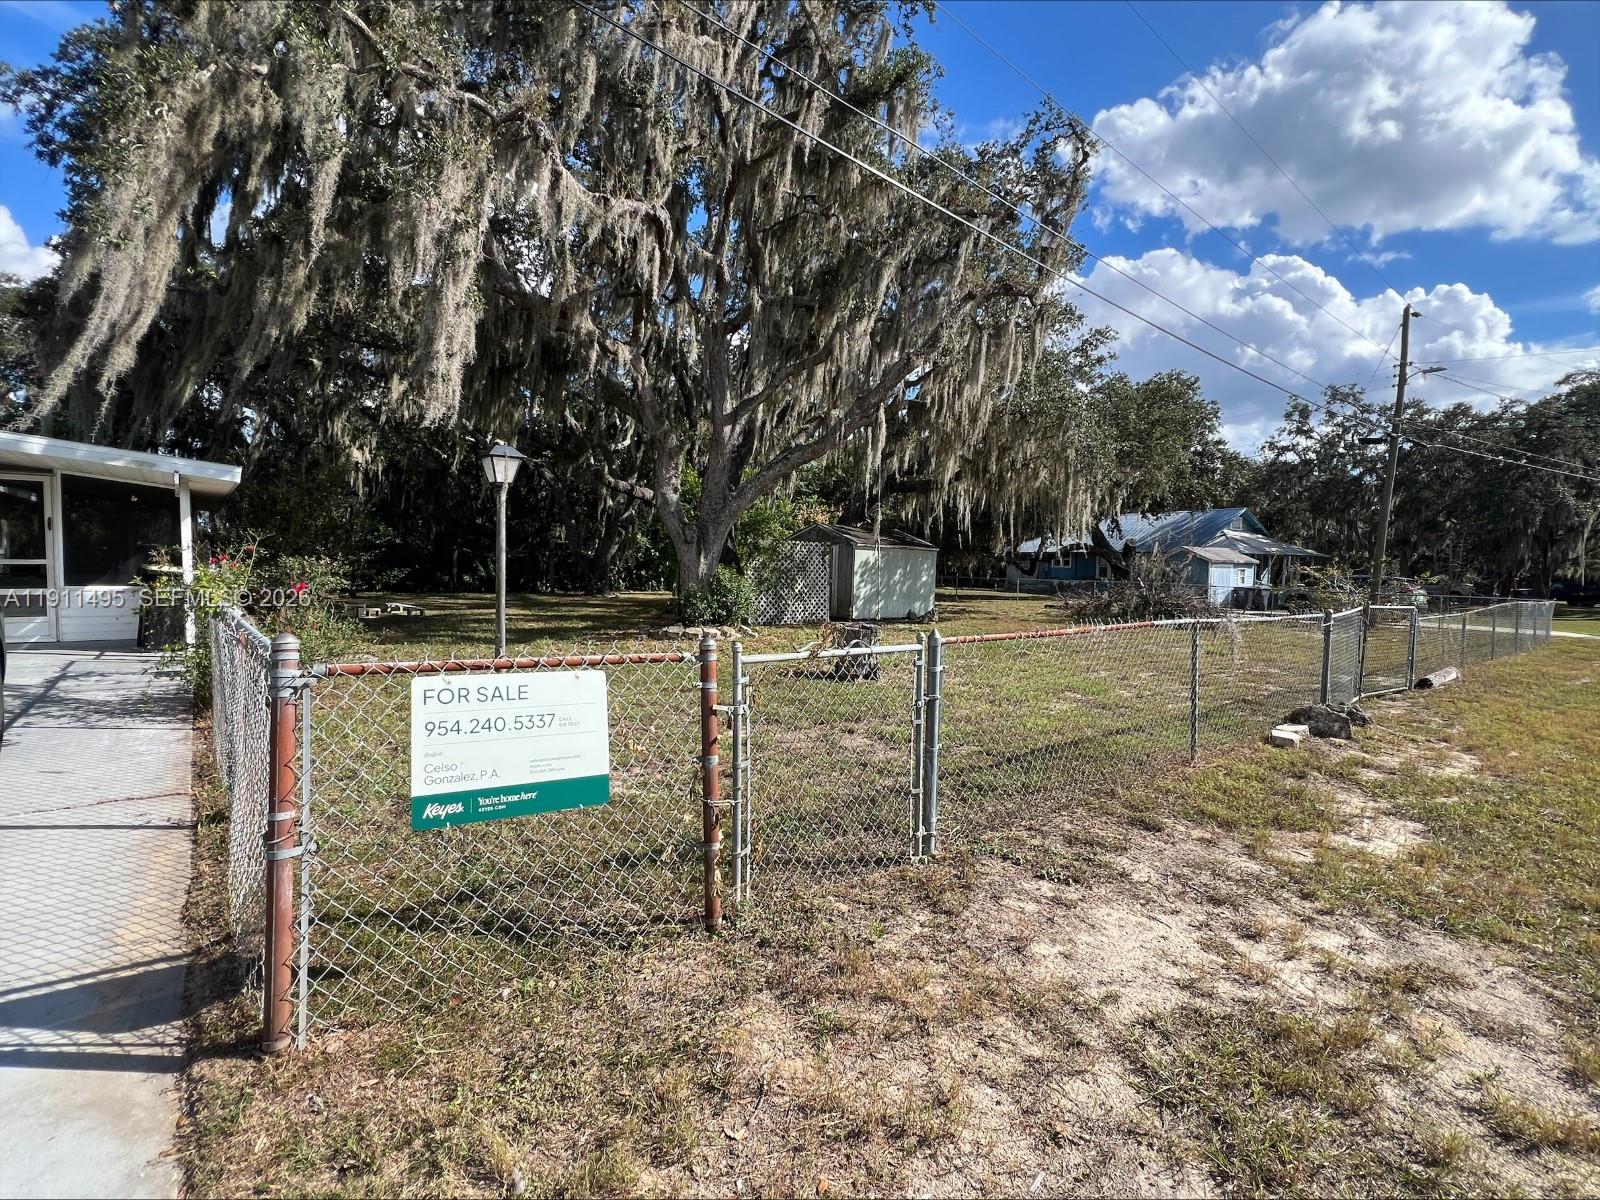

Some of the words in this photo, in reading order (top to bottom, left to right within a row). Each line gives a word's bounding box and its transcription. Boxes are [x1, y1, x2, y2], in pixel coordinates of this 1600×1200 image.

[423, 687, 470, 705] FOR
[477, 684, 529, 702] SALE
[424, 713, 556, 738] 954.240.5337
[424, 762, 458, 774] Celso
[480, 769, 501, 780] P.A.
[500, 794, 521, 803] home
[520, 791, 537, 801] here
